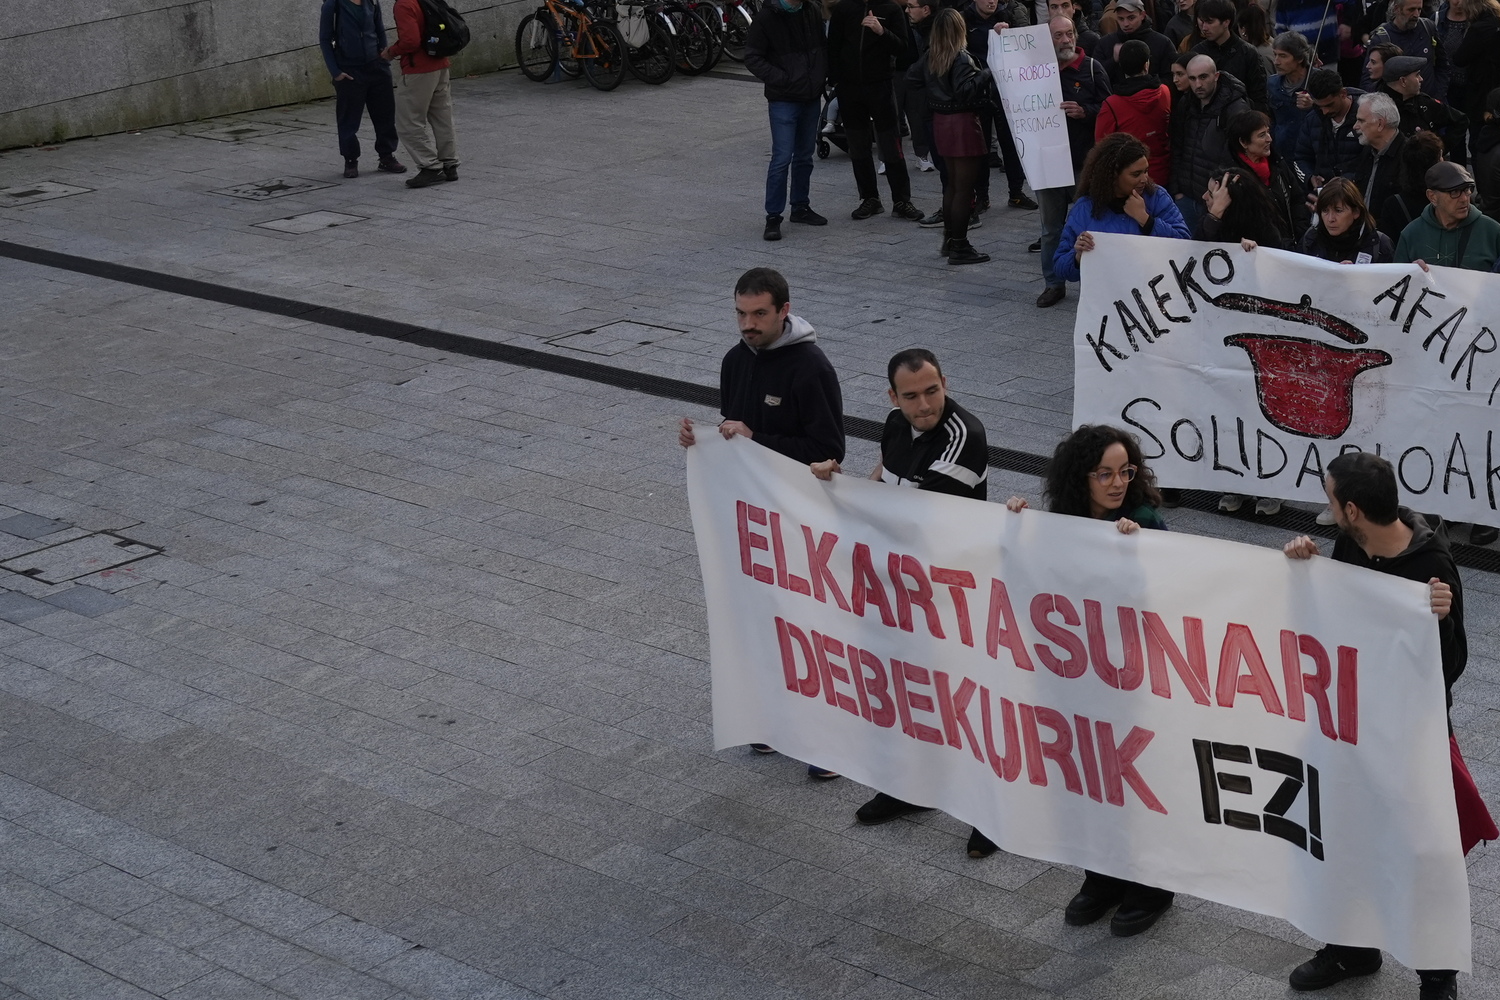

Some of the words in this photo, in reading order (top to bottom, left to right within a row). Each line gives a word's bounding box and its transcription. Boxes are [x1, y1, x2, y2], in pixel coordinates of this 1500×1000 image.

[1019, 63, 1056, 81] ROBOS:
[1023, 93, 1055, 112] CENA
[1085, 248, 1236, 373] KALEKO
[736, 499, 1359, 746] ELKARTASUNARI
[773, 615, 1169, 816] DEBEKURIK
[1192, 737, 1325, 863] EZ!
